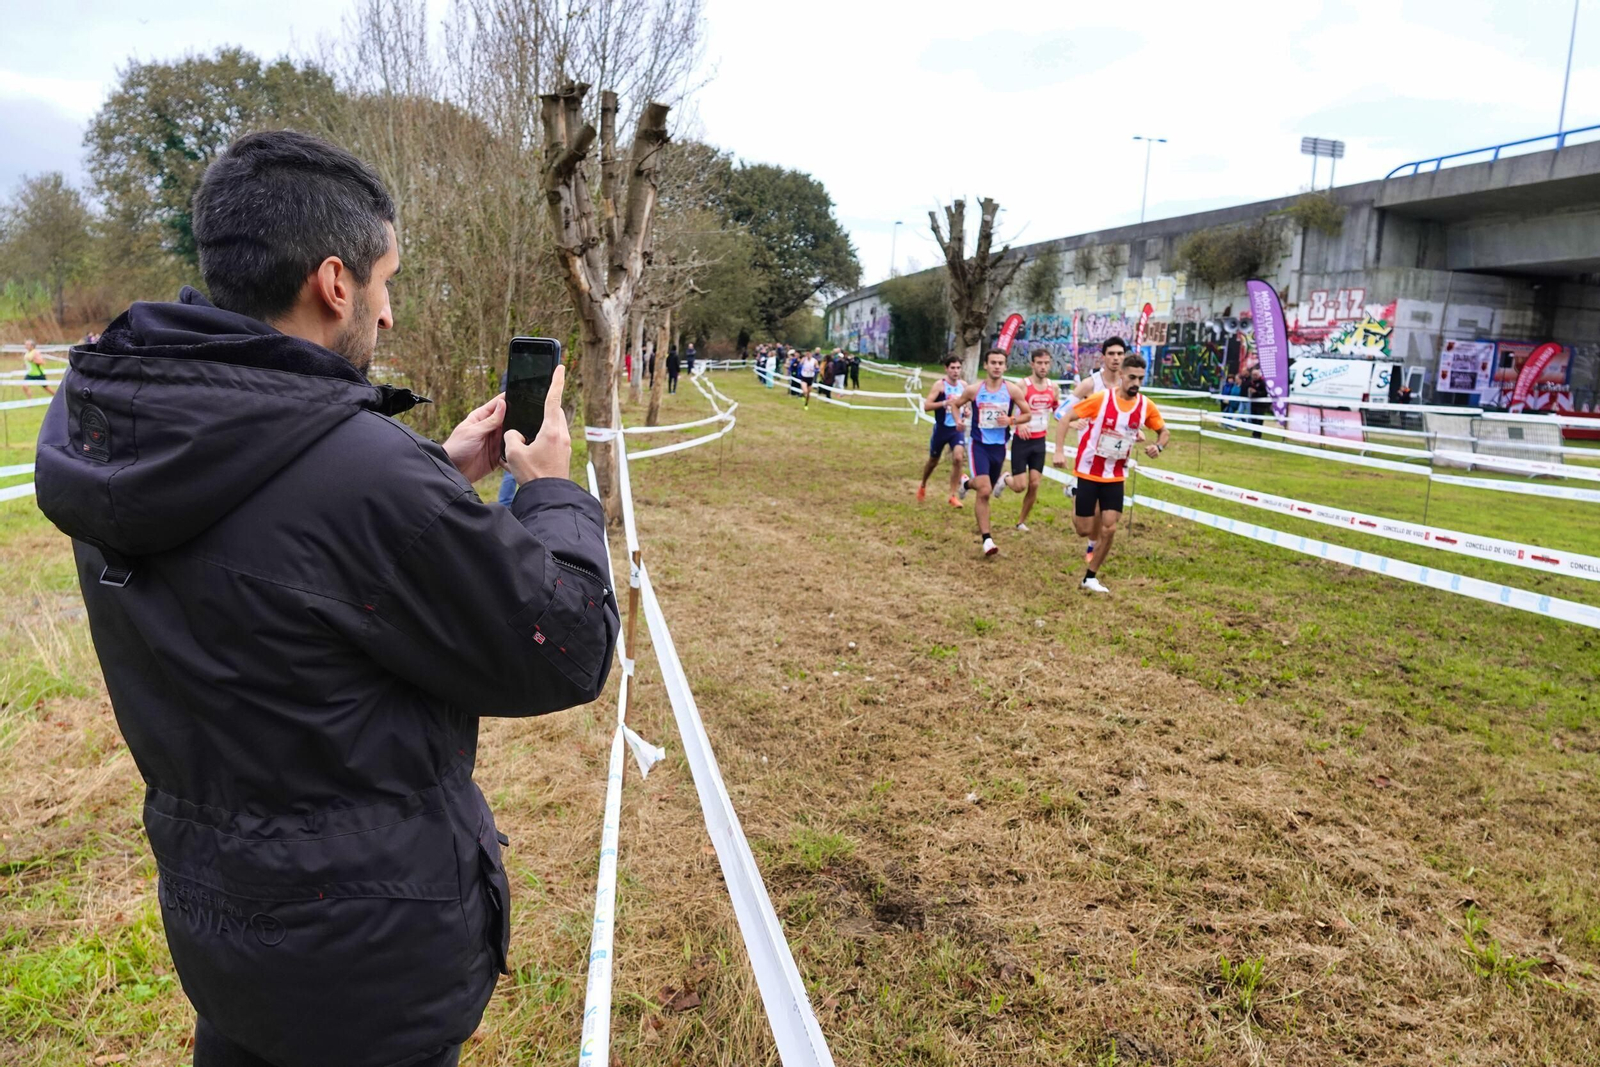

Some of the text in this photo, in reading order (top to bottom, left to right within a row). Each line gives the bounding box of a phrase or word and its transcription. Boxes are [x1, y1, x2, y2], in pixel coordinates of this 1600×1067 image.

[1114, 440, 1122, 450] 4
[1383, 525, 1404, 534] CONCELLO
[1465, 541, 1493, 552] CONCELLO
